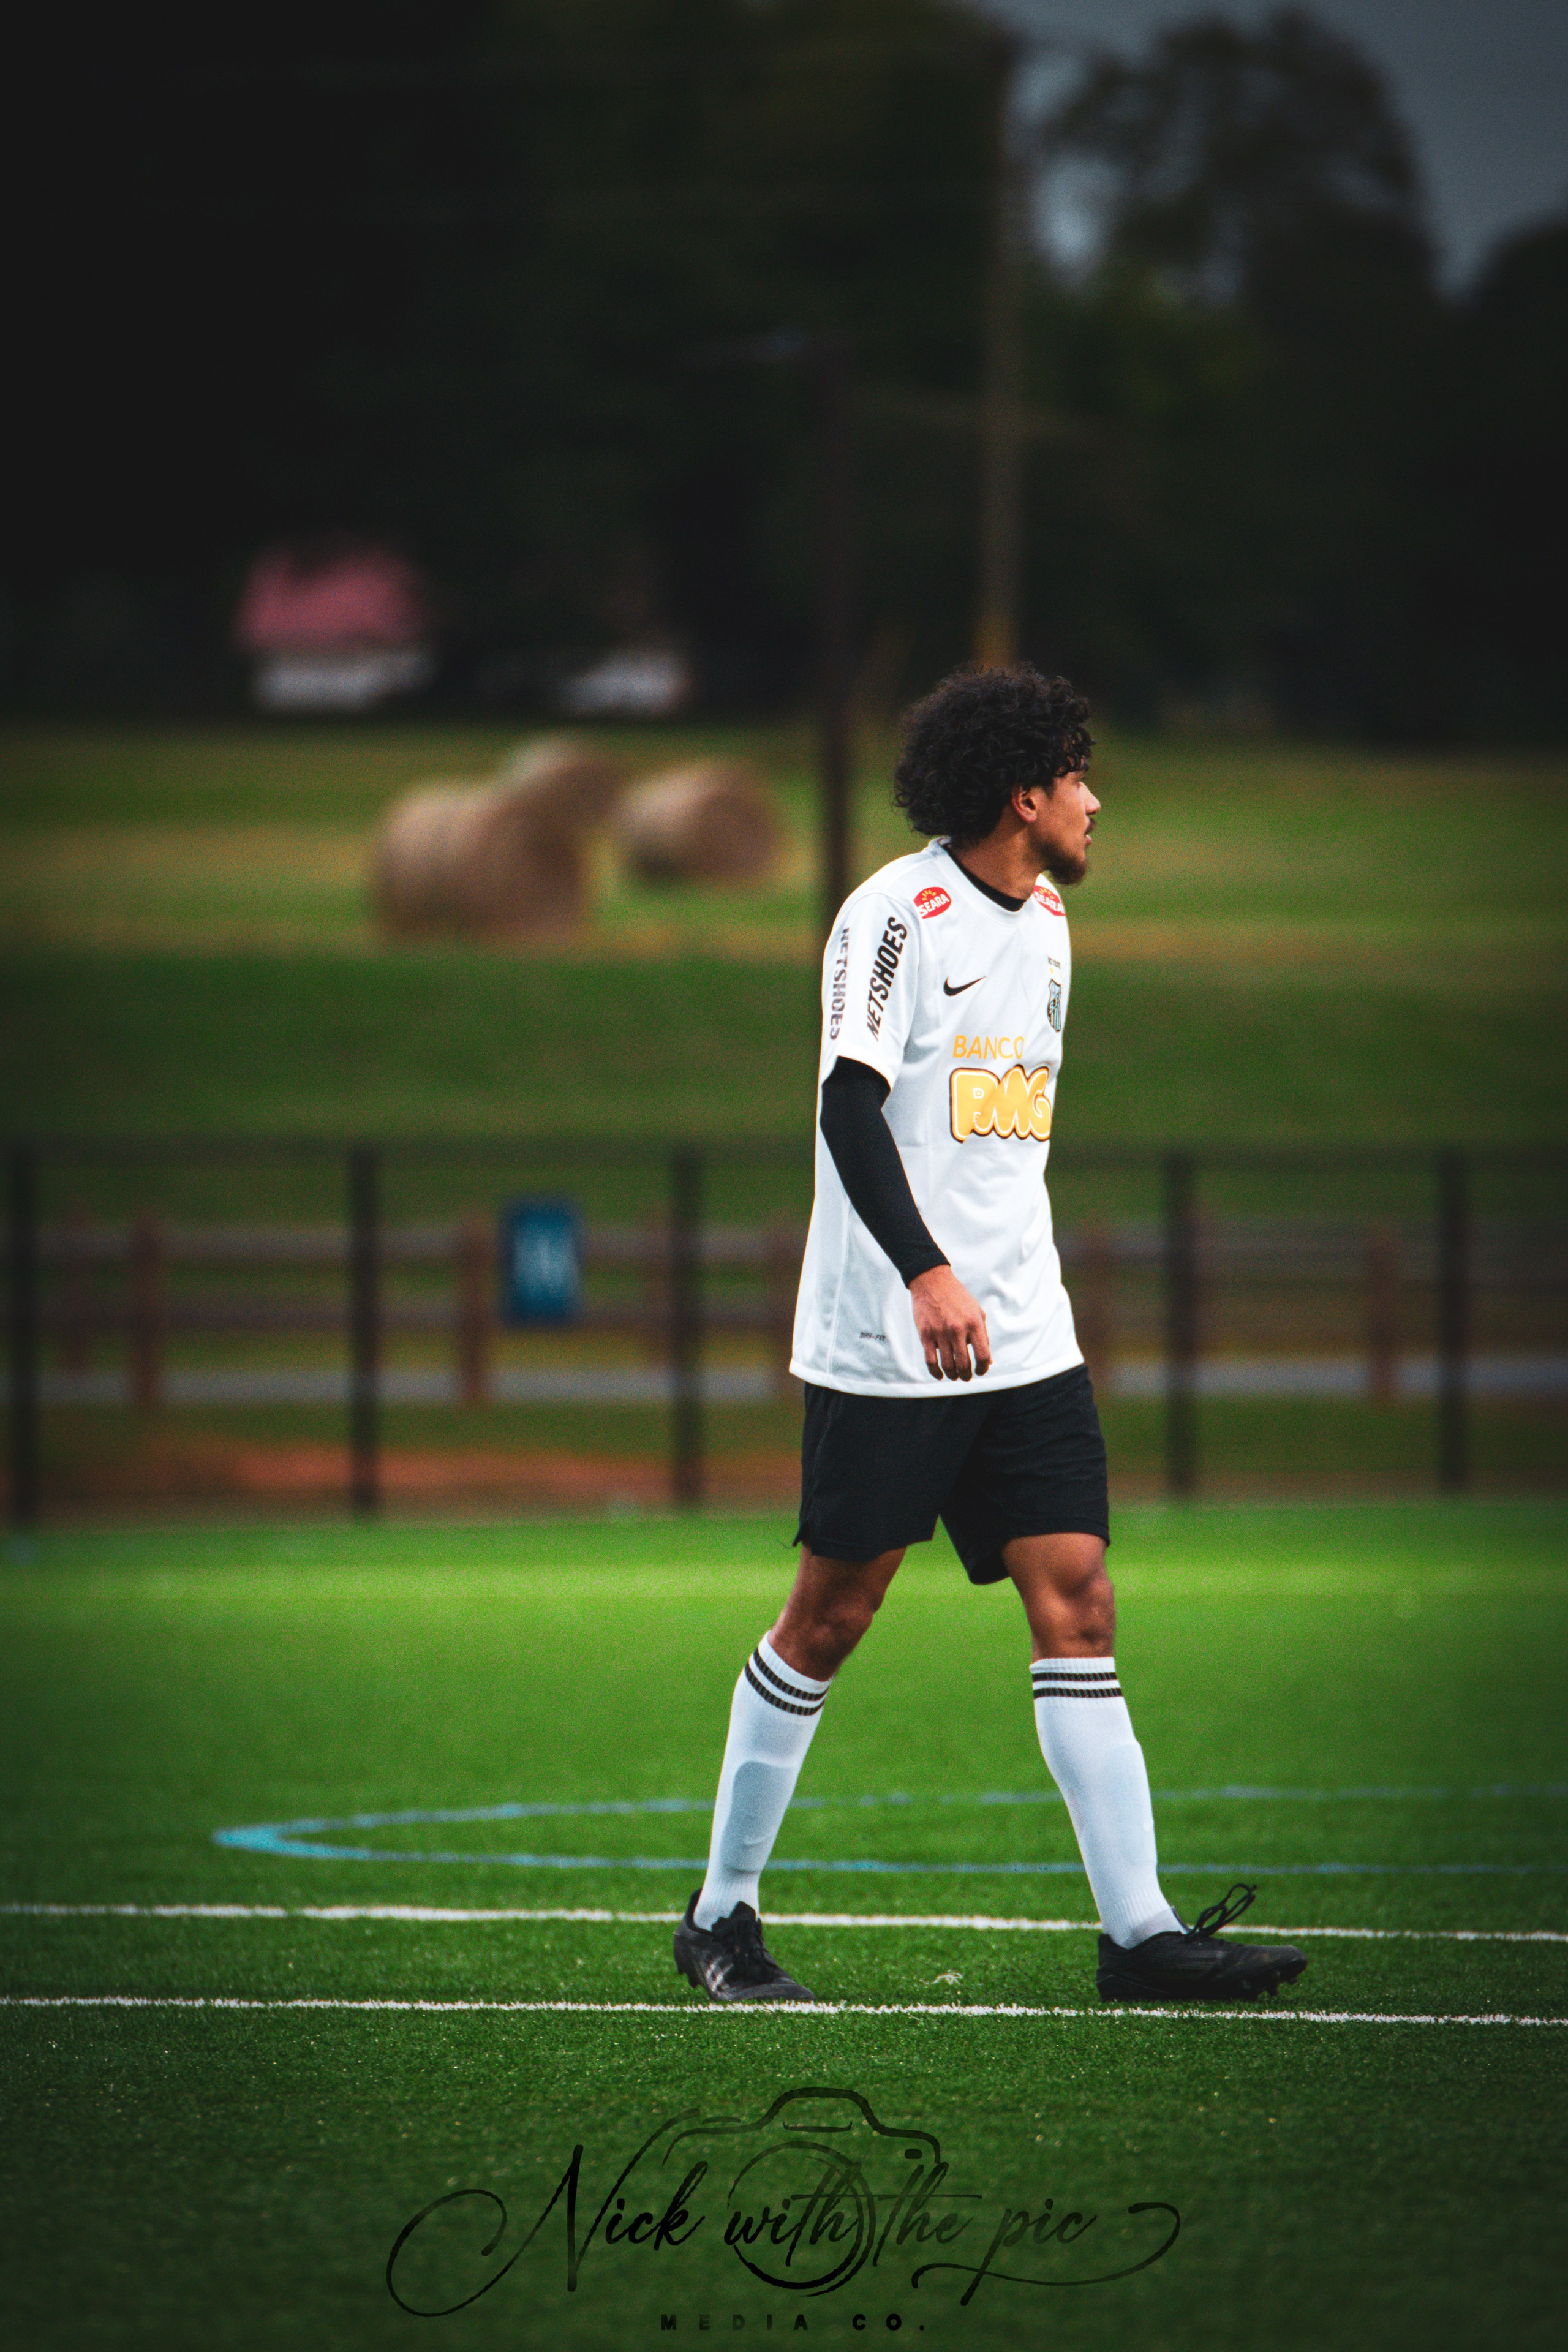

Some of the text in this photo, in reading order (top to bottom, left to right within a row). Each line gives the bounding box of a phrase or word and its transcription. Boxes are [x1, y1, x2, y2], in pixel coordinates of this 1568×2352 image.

[919, 894, 949, 918] SEARA
[1034, 891, 1065, 914] SEARA
[829, 927, 850, 1041] NETSHOES
[867, 916, 908, 1042] NETSHOES
[952, 1035, 1025, 1060] BANCO
